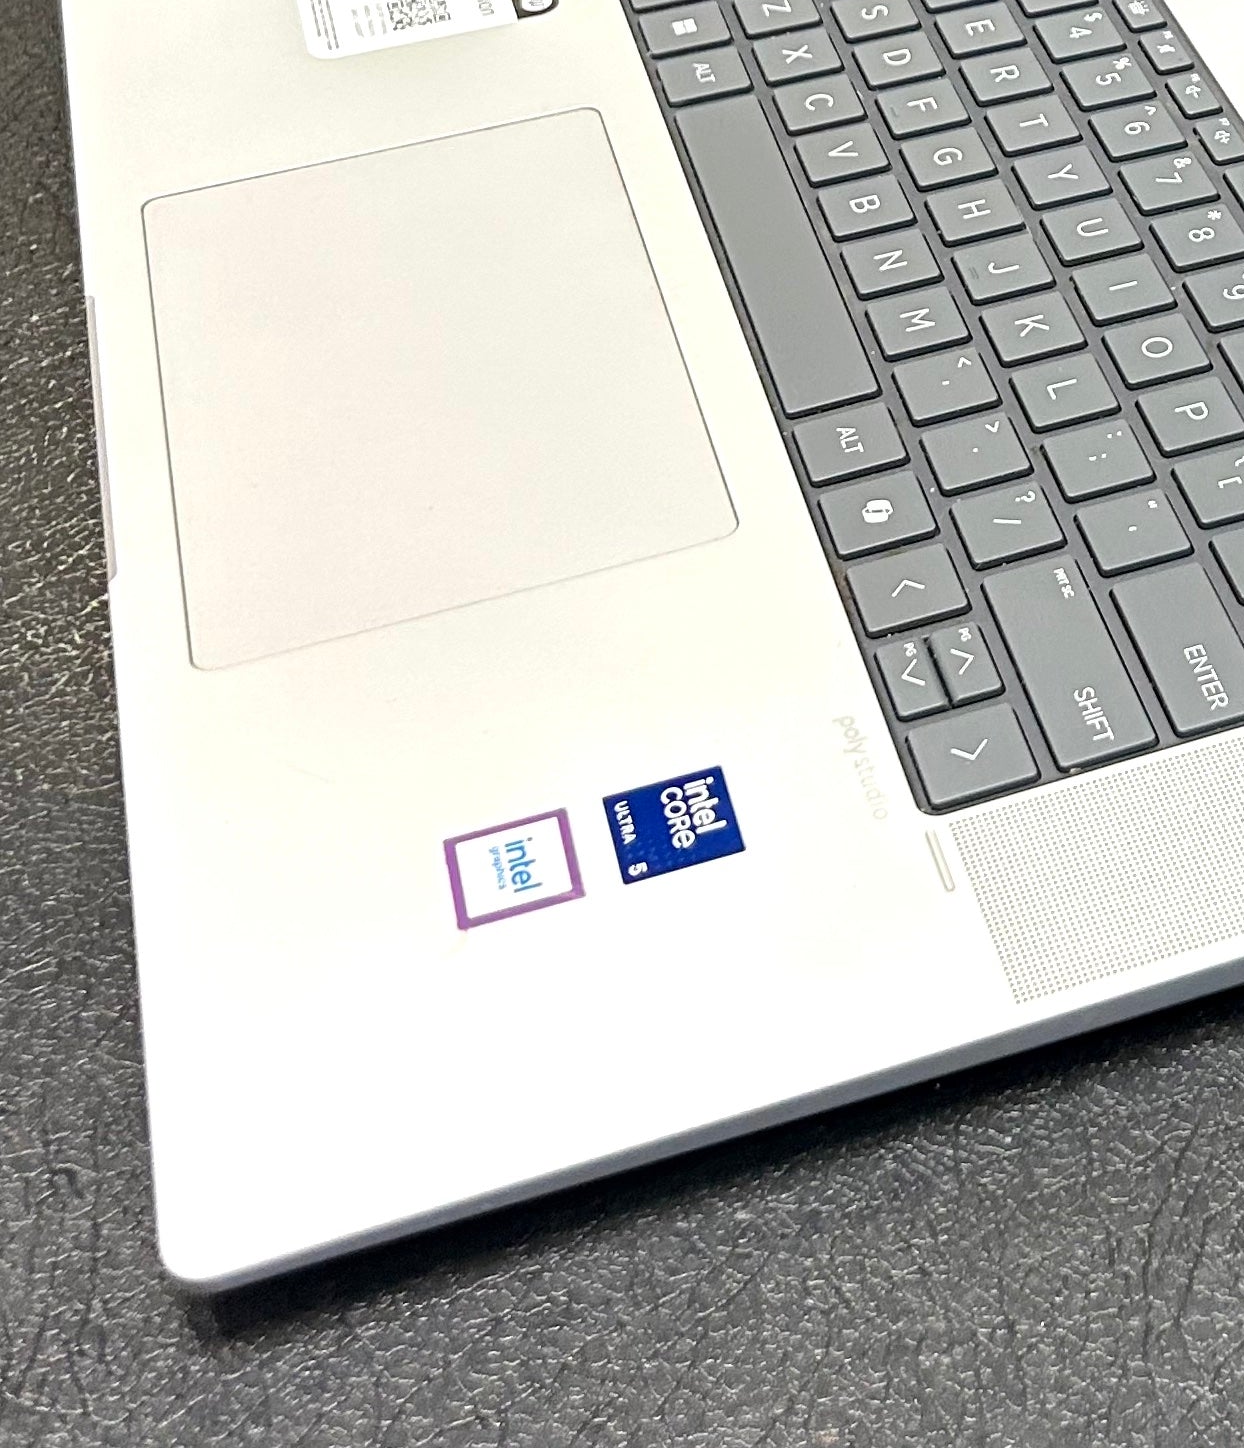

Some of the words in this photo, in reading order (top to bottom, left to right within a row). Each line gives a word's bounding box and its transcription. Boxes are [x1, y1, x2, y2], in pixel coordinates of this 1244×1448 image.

[761, 0, 792, 17] Z
[861, 5, 889, 20] S
[965, 19, 996, 37] E
[1069, 26, 1093, 39] 4
[781, 44, 813, 65] X
[882, 48, 911, 66] D
[1112, 56, 1132, 70] %
[692, 63, 716, 83] ALT
[989, 64, 1020, 83] R
[1095, 72, 1122, 86] 5
[805, 93, 834, 111] C
[906, 96, 938, 112] F
[1019, 113, 1049, 128] T
[1124, 121, 1151, 135] 6
[827, 140, 859, 157] V
[933, 147, 963, 166] G
[1047, 163, 1079, 180] Y
[1155, 171, 1183, 183] 7
[849, 194, 881, 214] B
[957, 198, 991, 220] H
[1076, 217, 1109, 237] U
[1188, 227, 1215, 243] 8
[873, 249, 908, 271] N
[987, 262, 1020, 274] J
[1108, 280, 1138, 291] I
[899, 308, 936, 332] M
[1014, 314, 1050, 338] K
[1141, 336, 1173, 359] O
[1046, 378, 1077, 401] L
[1174, 401, 1209, 421] P
[835, 427, 865, 453] ALT
[1014, 490, 1036, 503] ?
[903, 641, 918, 657] PG
[1183, 644, 1229, 711] ENTER
[1073, 686, 1115, 741] SHIFT
[683, 776, 727, 834] intel
[614, 800, 637, 845] ULTRA
[628, 862, 648, 877] 5
[488, 846, 507, 891] graphics
[504, 836, 543, 894] intel
